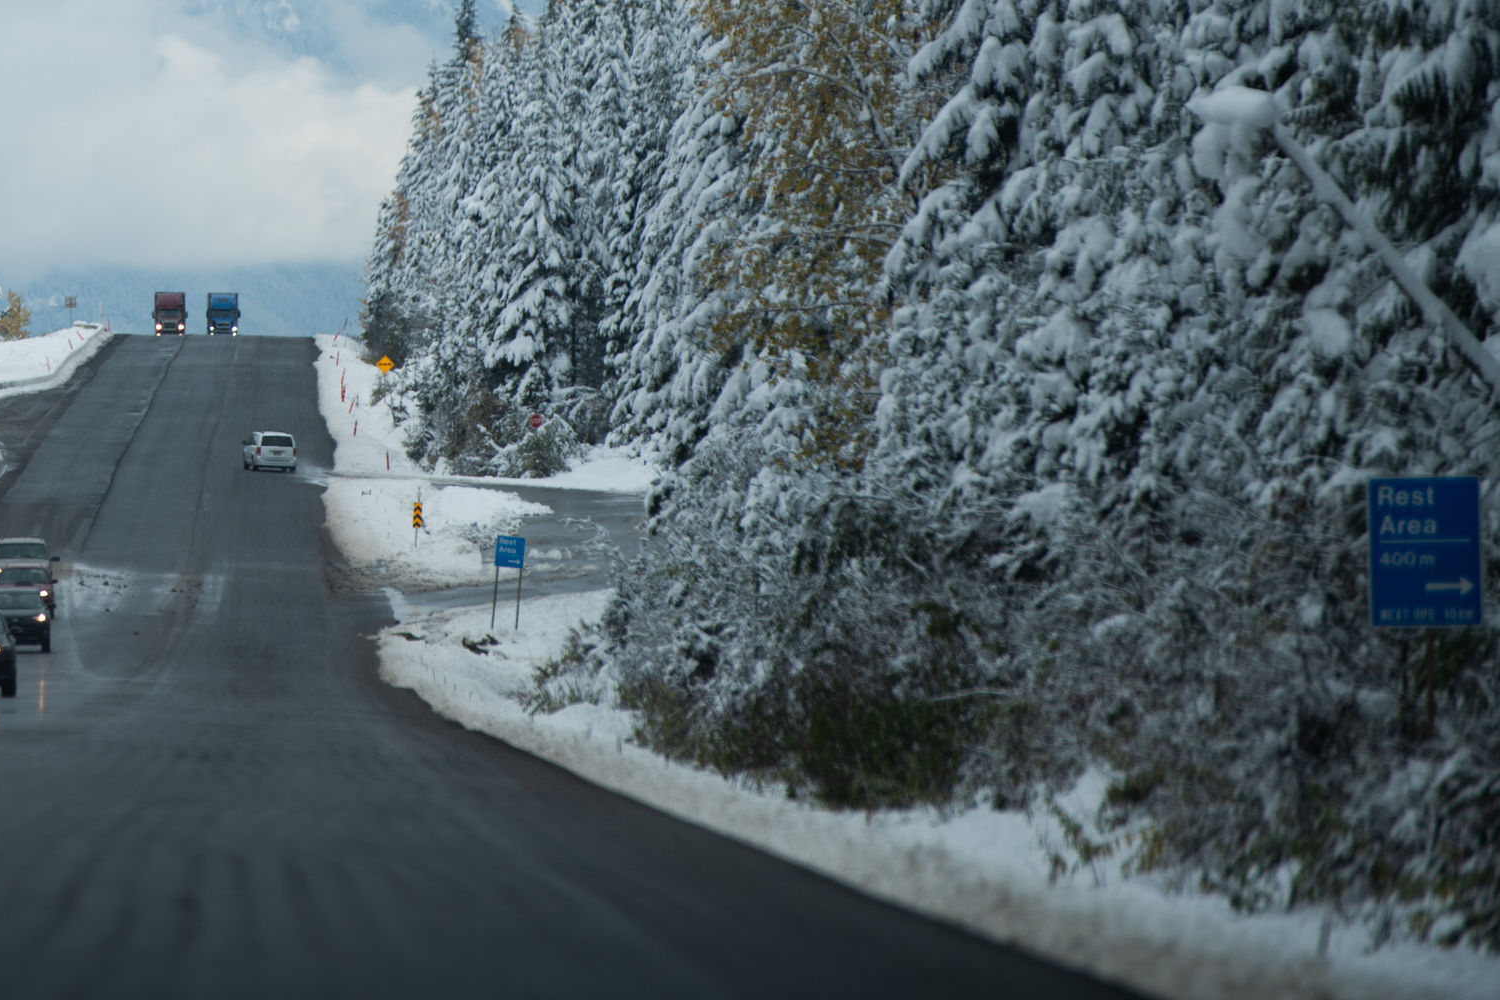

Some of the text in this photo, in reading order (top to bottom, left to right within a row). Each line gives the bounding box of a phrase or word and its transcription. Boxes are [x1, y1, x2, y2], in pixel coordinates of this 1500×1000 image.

[1377, 485, 1436, 506] Rest
[1379, 514, 1438, 535] Area
[499, 537, 517, 546] Rest
[499, 546, 517, 554] Area
[1379, 551, 1436, 567] 400 m
